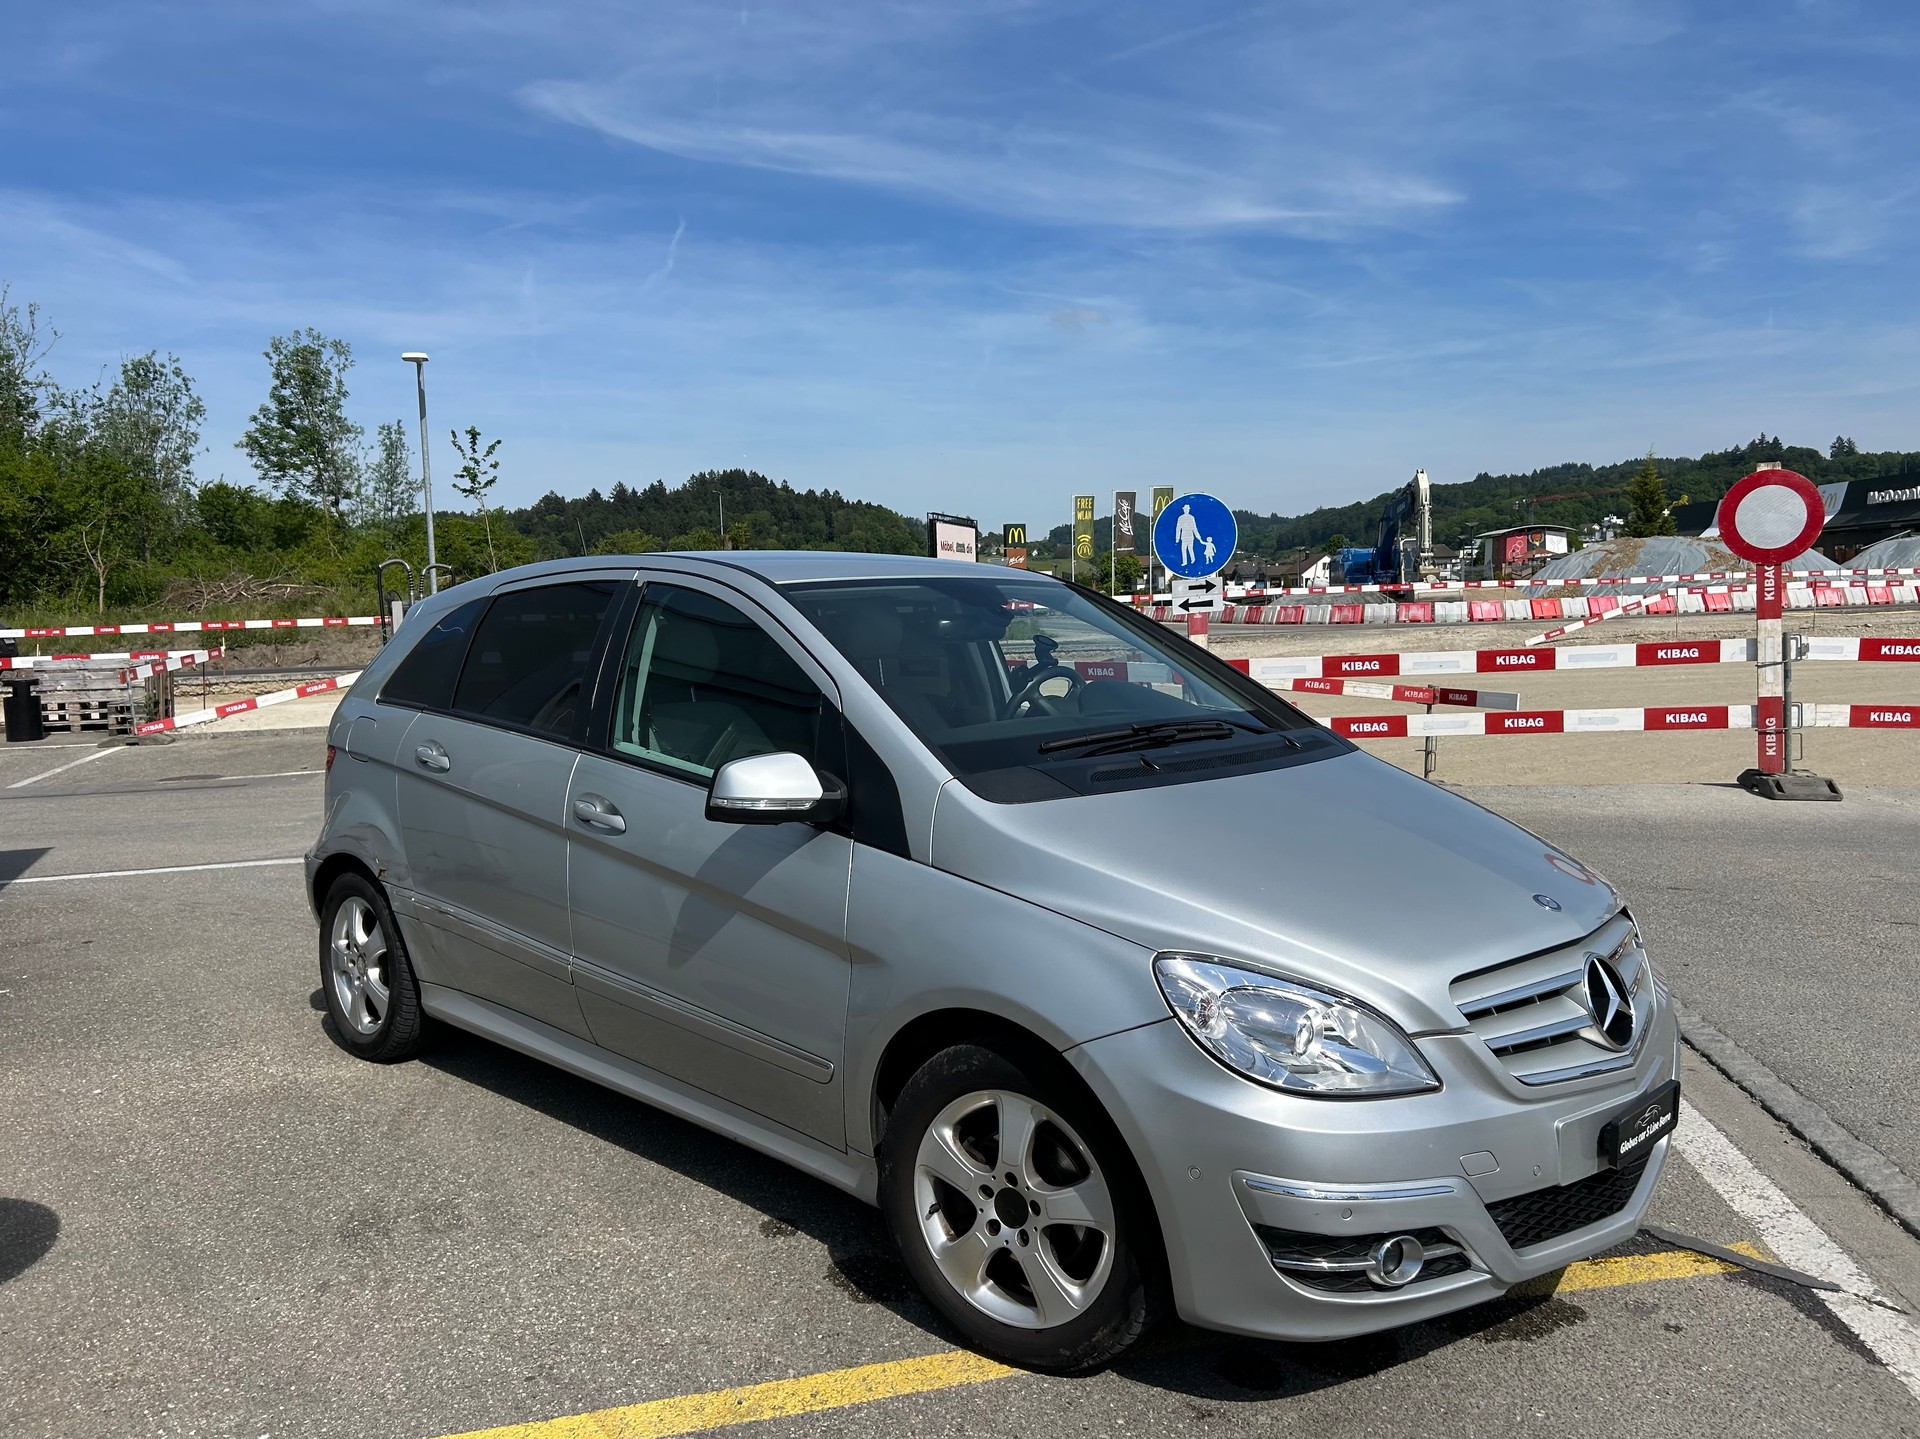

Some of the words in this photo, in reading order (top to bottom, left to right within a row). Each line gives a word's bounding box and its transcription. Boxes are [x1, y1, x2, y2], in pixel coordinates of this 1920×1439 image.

[1077, 498, 1092, 509] FREE
[1077, 510, 1092, 520] WLAN
[1657, 648, 1699, 659] KIBAG
[1881, 645, 1920, 655] KIBAG
[1496, 654, 1536, 665] KIBAG
[1341, 661, 1380, 671] KIBAG
[1087, 667, 1115, 677] KIBAG
[306, 683, 327, 693] KIBAG
[1305, 680, 1331, 690] KIBAG
[1448, 692, 1468, 702] KIBAG
[225, 702, 248, 713] KIBAG
[1665, 713, 1708, 724] KIBAG
[1870, 712, 1911, 722] KIBAG
[142, 722, 165, 732] KIBAG
[1350, 722, 1389, 733] KIBAG
[1504, 717, 1544, 728] KIBAG
[1765, 717, 1777, 756] KIBAG
[1620, 1136, 1638, 1154] Globus
